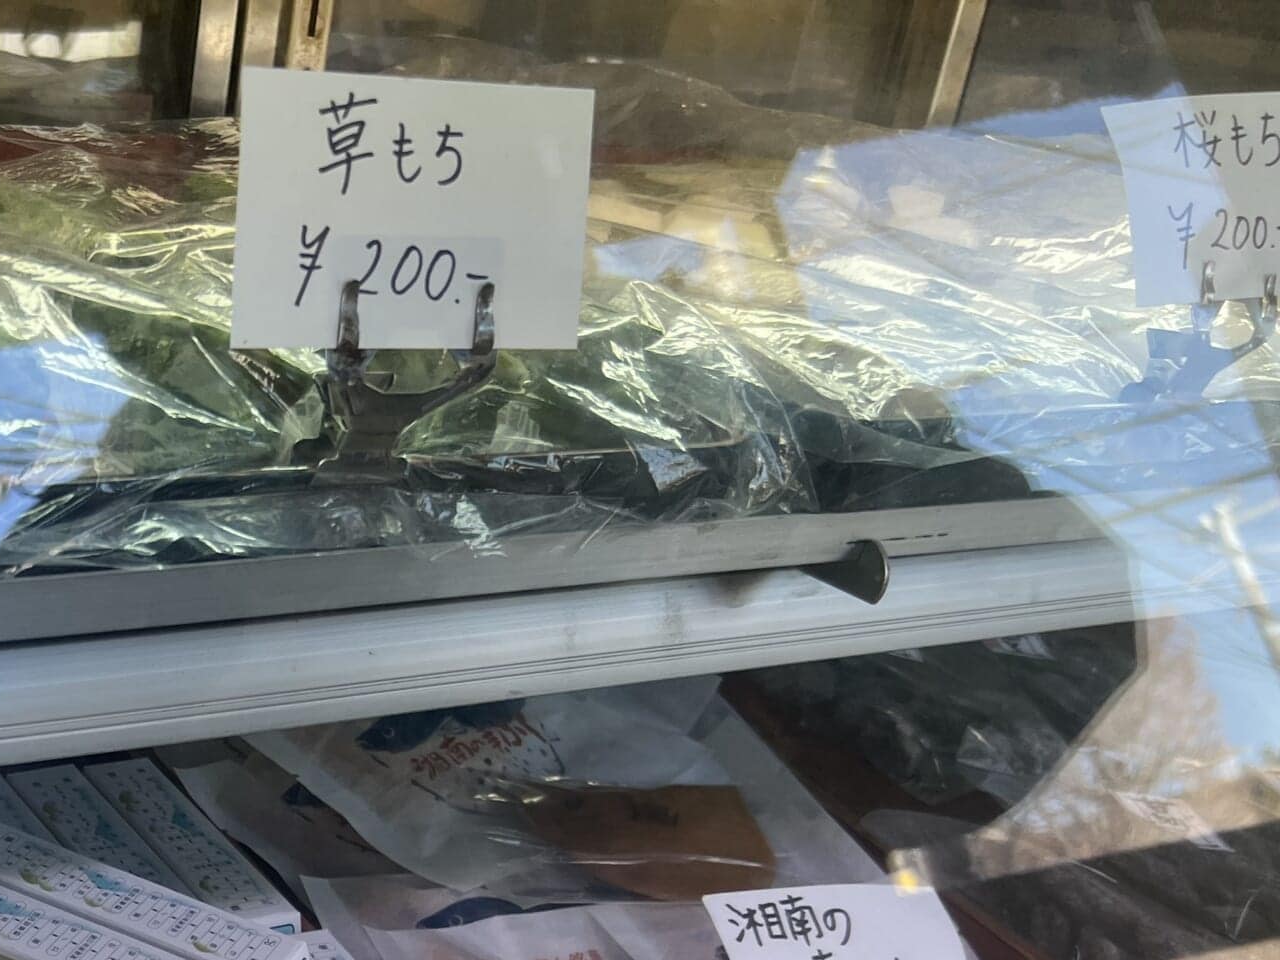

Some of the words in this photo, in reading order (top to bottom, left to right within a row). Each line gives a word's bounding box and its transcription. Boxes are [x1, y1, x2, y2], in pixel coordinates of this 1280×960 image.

[318, 91, 464, 195] 草もち
[1173, 110, 1280, 169] 桜もち
[725, 894, 852, 947] 湘南の
